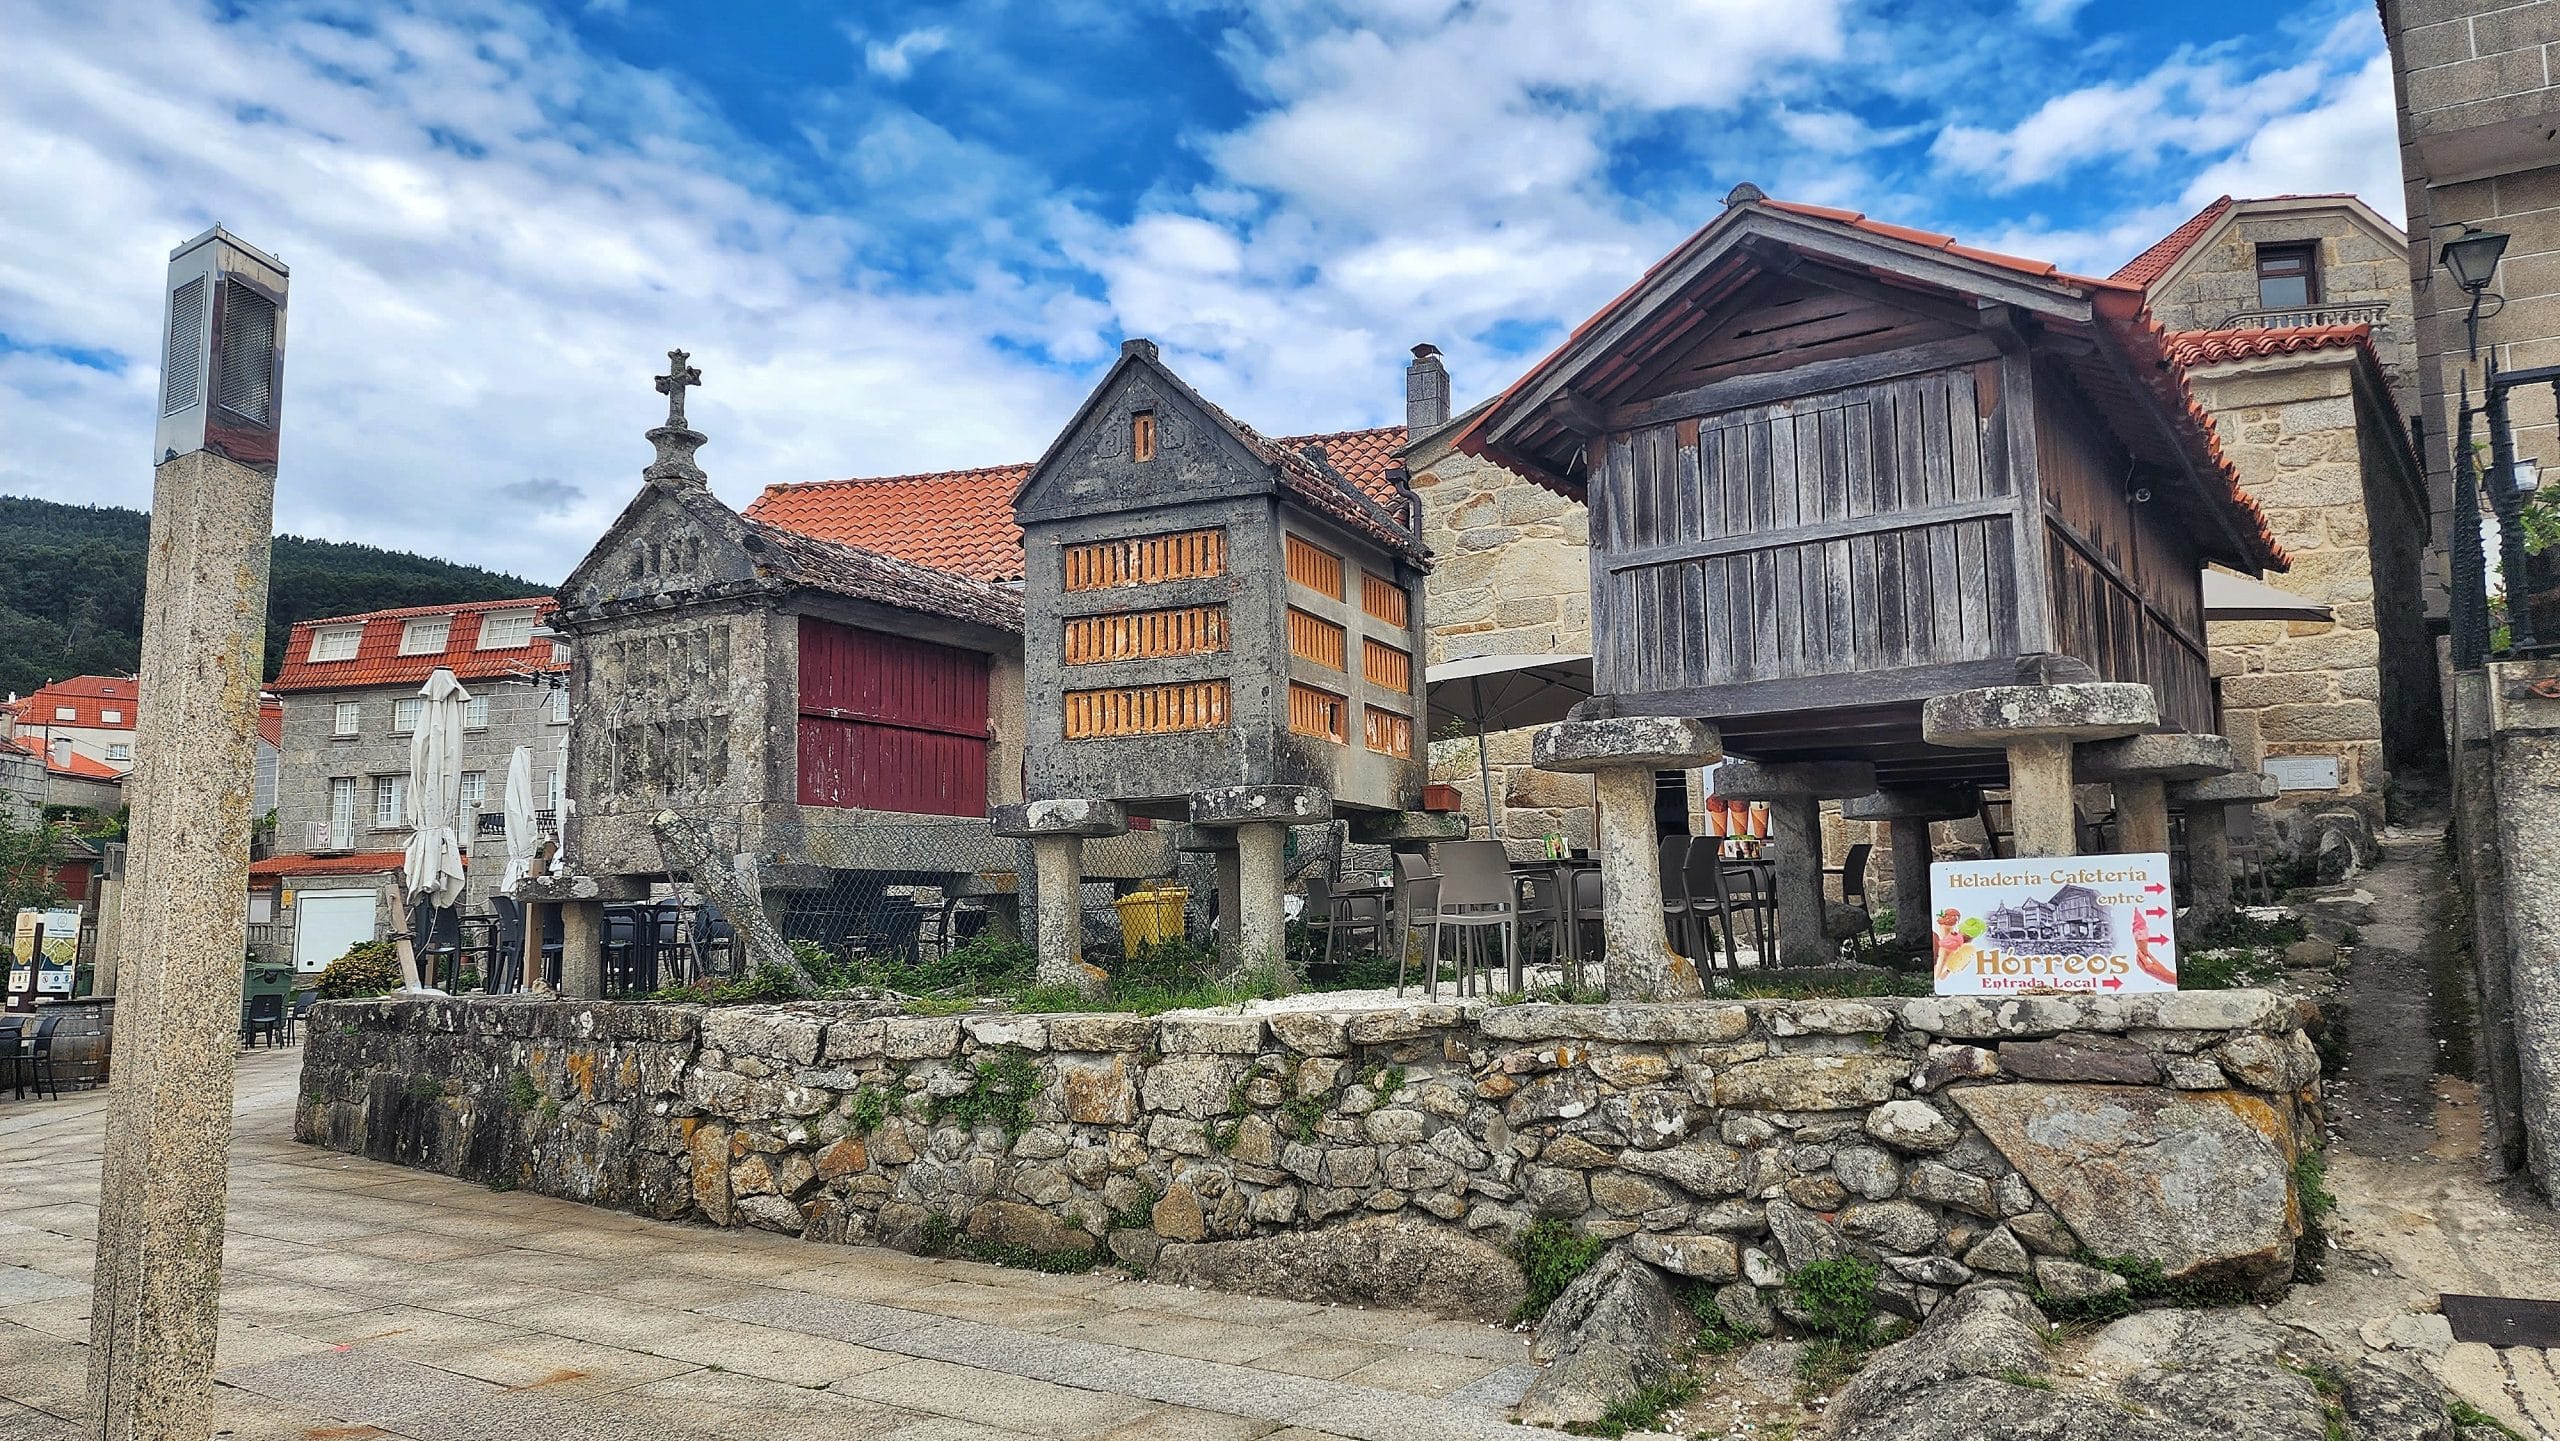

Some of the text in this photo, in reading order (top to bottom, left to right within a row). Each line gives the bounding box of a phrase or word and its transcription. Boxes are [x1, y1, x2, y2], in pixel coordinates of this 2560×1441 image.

[1949, 867, 2147, 888] Heladería-Cafetería
[2098, 893, 2144, 905] entre
[1976, 948, 2129, 975] Hórreos
[1982, 977, 2096, 989] Entrada Local
